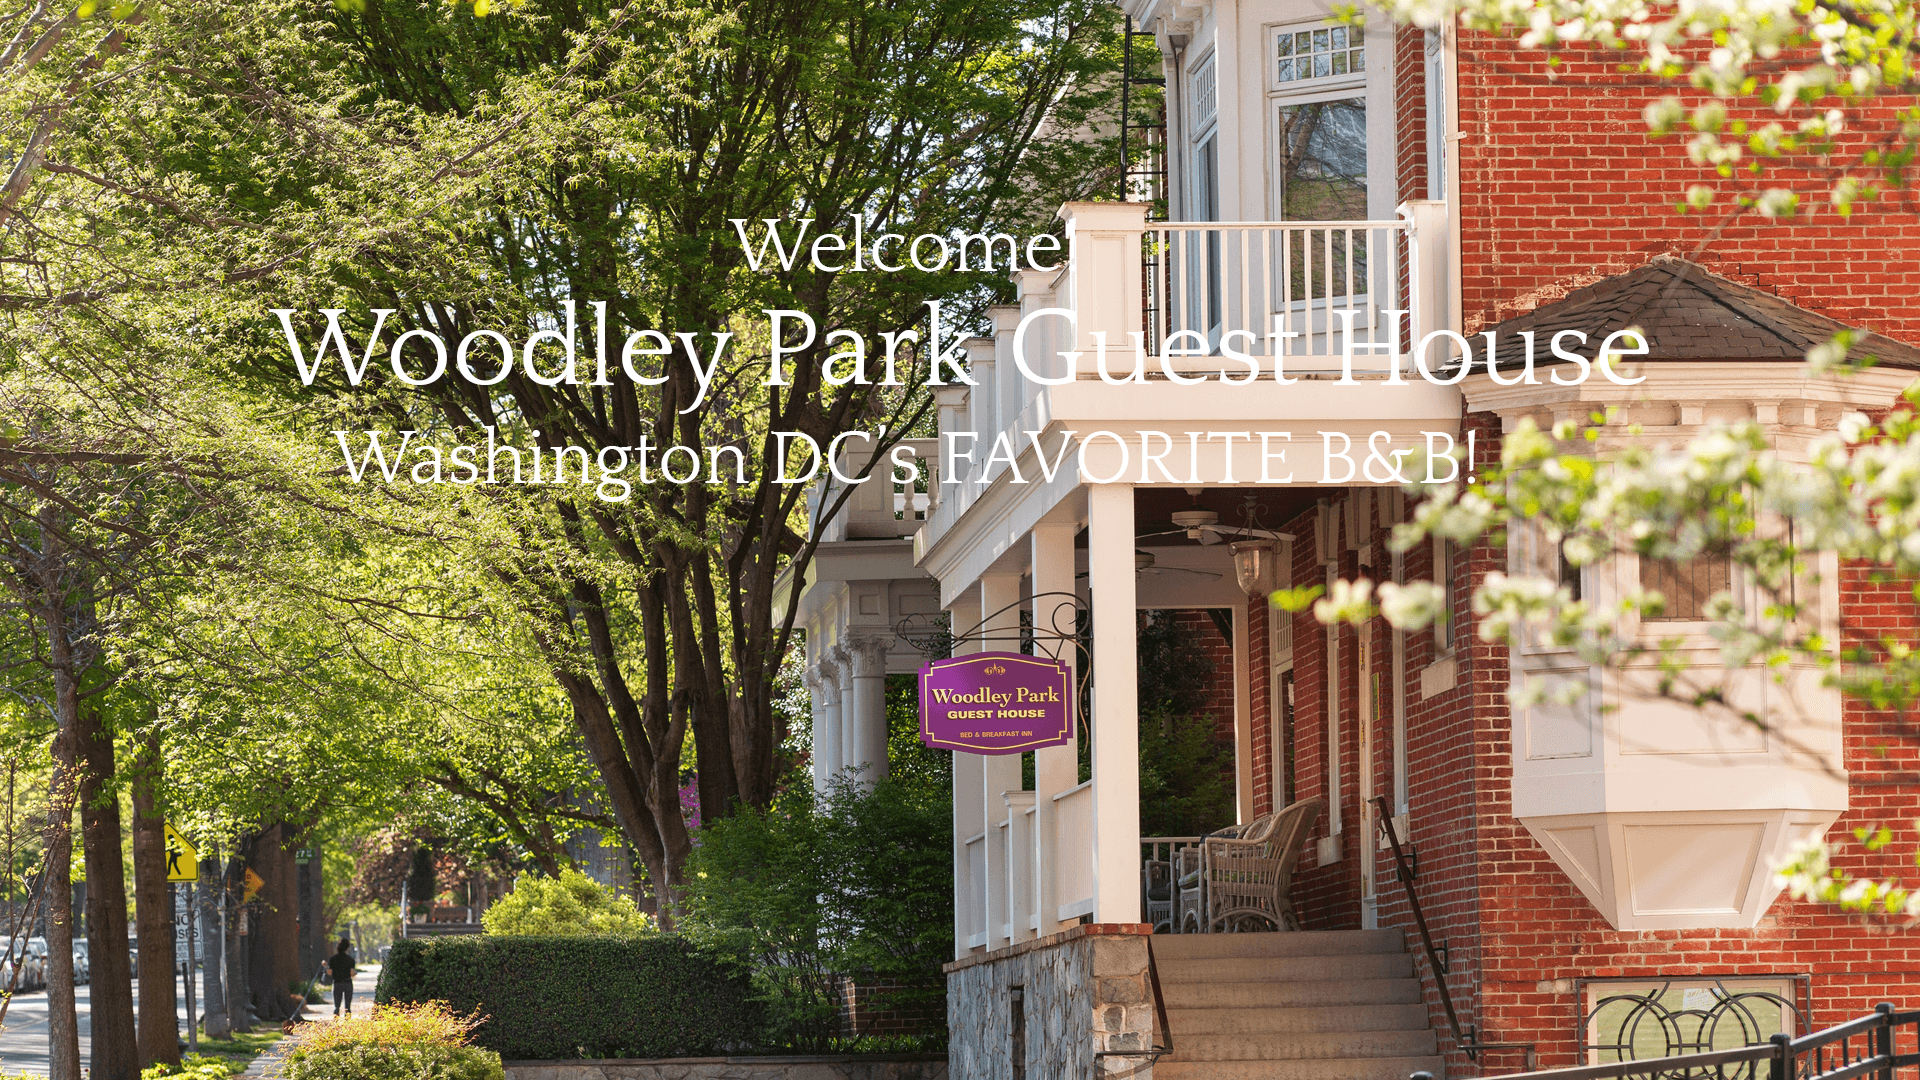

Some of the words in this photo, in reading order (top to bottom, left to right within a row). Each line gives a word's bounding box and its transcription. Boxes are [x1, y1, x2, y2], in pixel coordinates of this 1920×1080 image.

[932, 687, 1012, 708] Woodley
[1015, 685, 1060, 703] Park
[947, 709, 994, 720] GUEST
[997, 709, 1046, 719] HOUSE
[959, 731, 973, 739] BED
[981, 730, 1020, 739] BREAKFAST
[1021, 730, 1033, 738] INN
